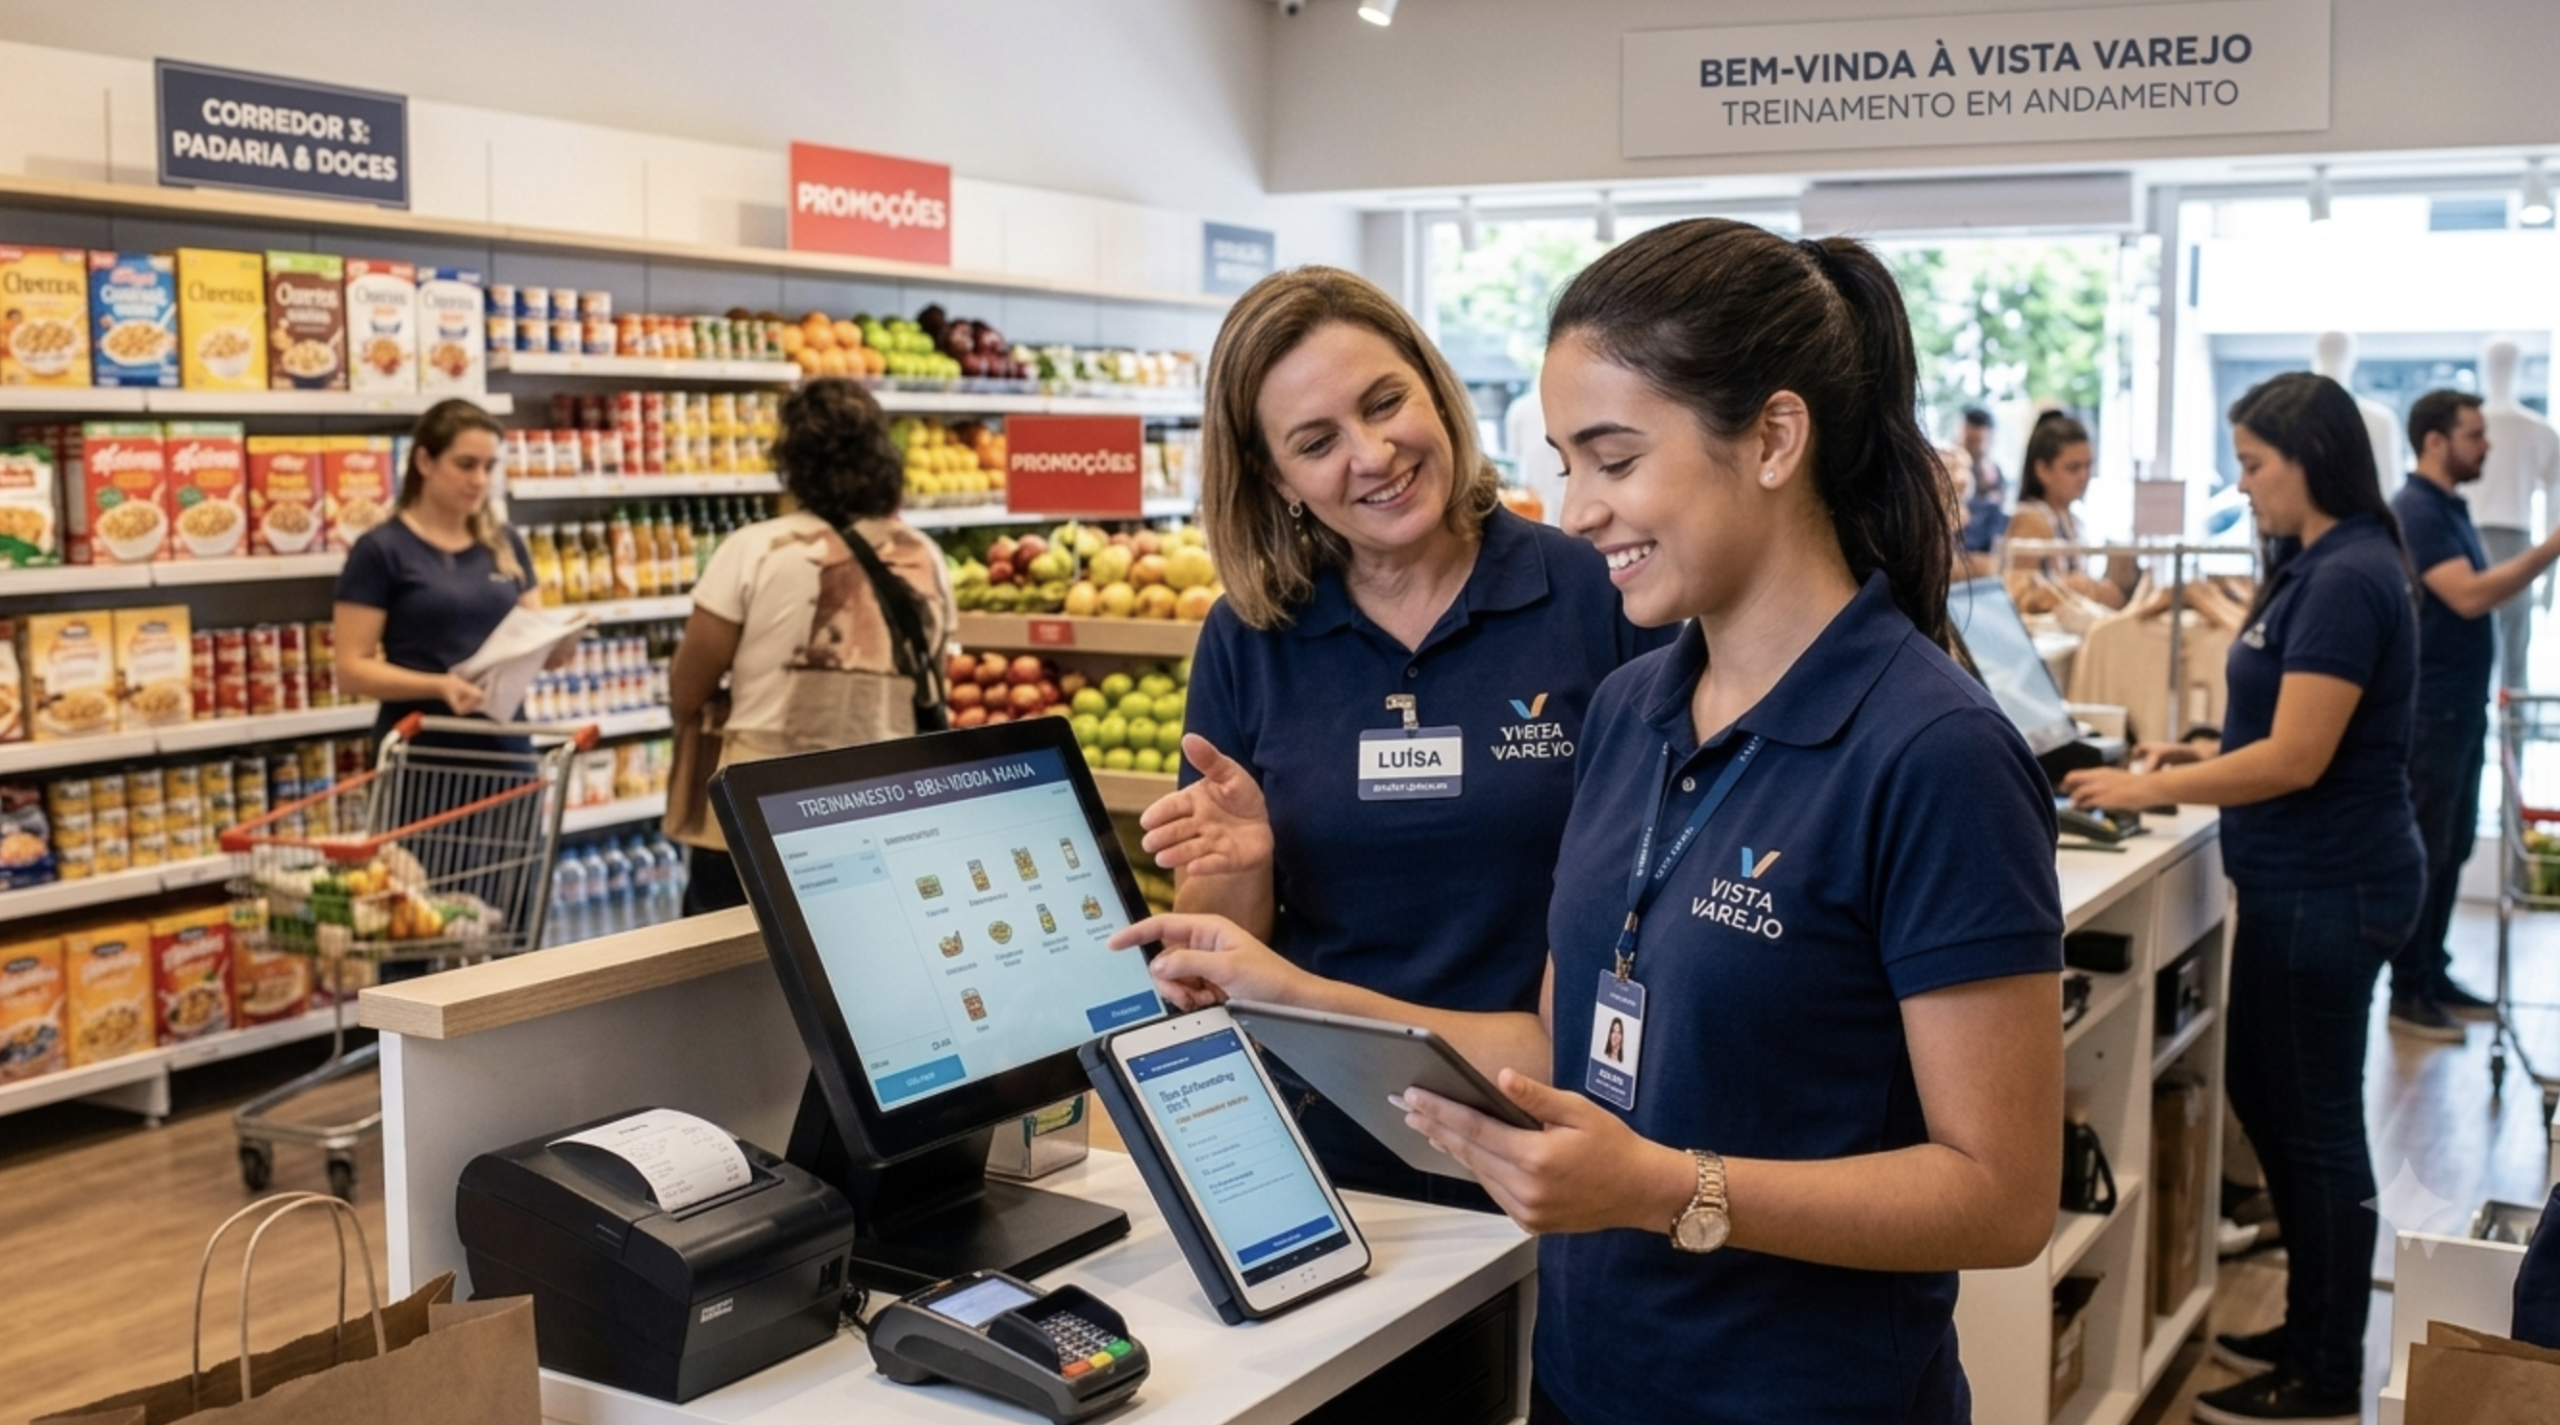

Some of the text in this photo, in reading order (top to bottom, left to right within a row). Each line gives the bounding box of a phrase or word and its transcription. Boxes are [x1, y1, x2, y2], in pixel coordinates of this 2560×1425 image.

[1700, 33, 2253, 88] BEM-VINDA À VISTA VAREJO
[202, 98, 343, 142] CORREDOR
[1721, 79, 2239, 126] TREINAMENTO EM ANDAMENTO
[173, 130, 398, 182] PADARIA & DOCES
[797, 181, 947, 230] PROMOÇÕES
[1378, 747, 1442, 768] LUÍSA
[1691, 896, 1784, 940] VAREJO
[1711, 877, 1773, 914] VISTA
